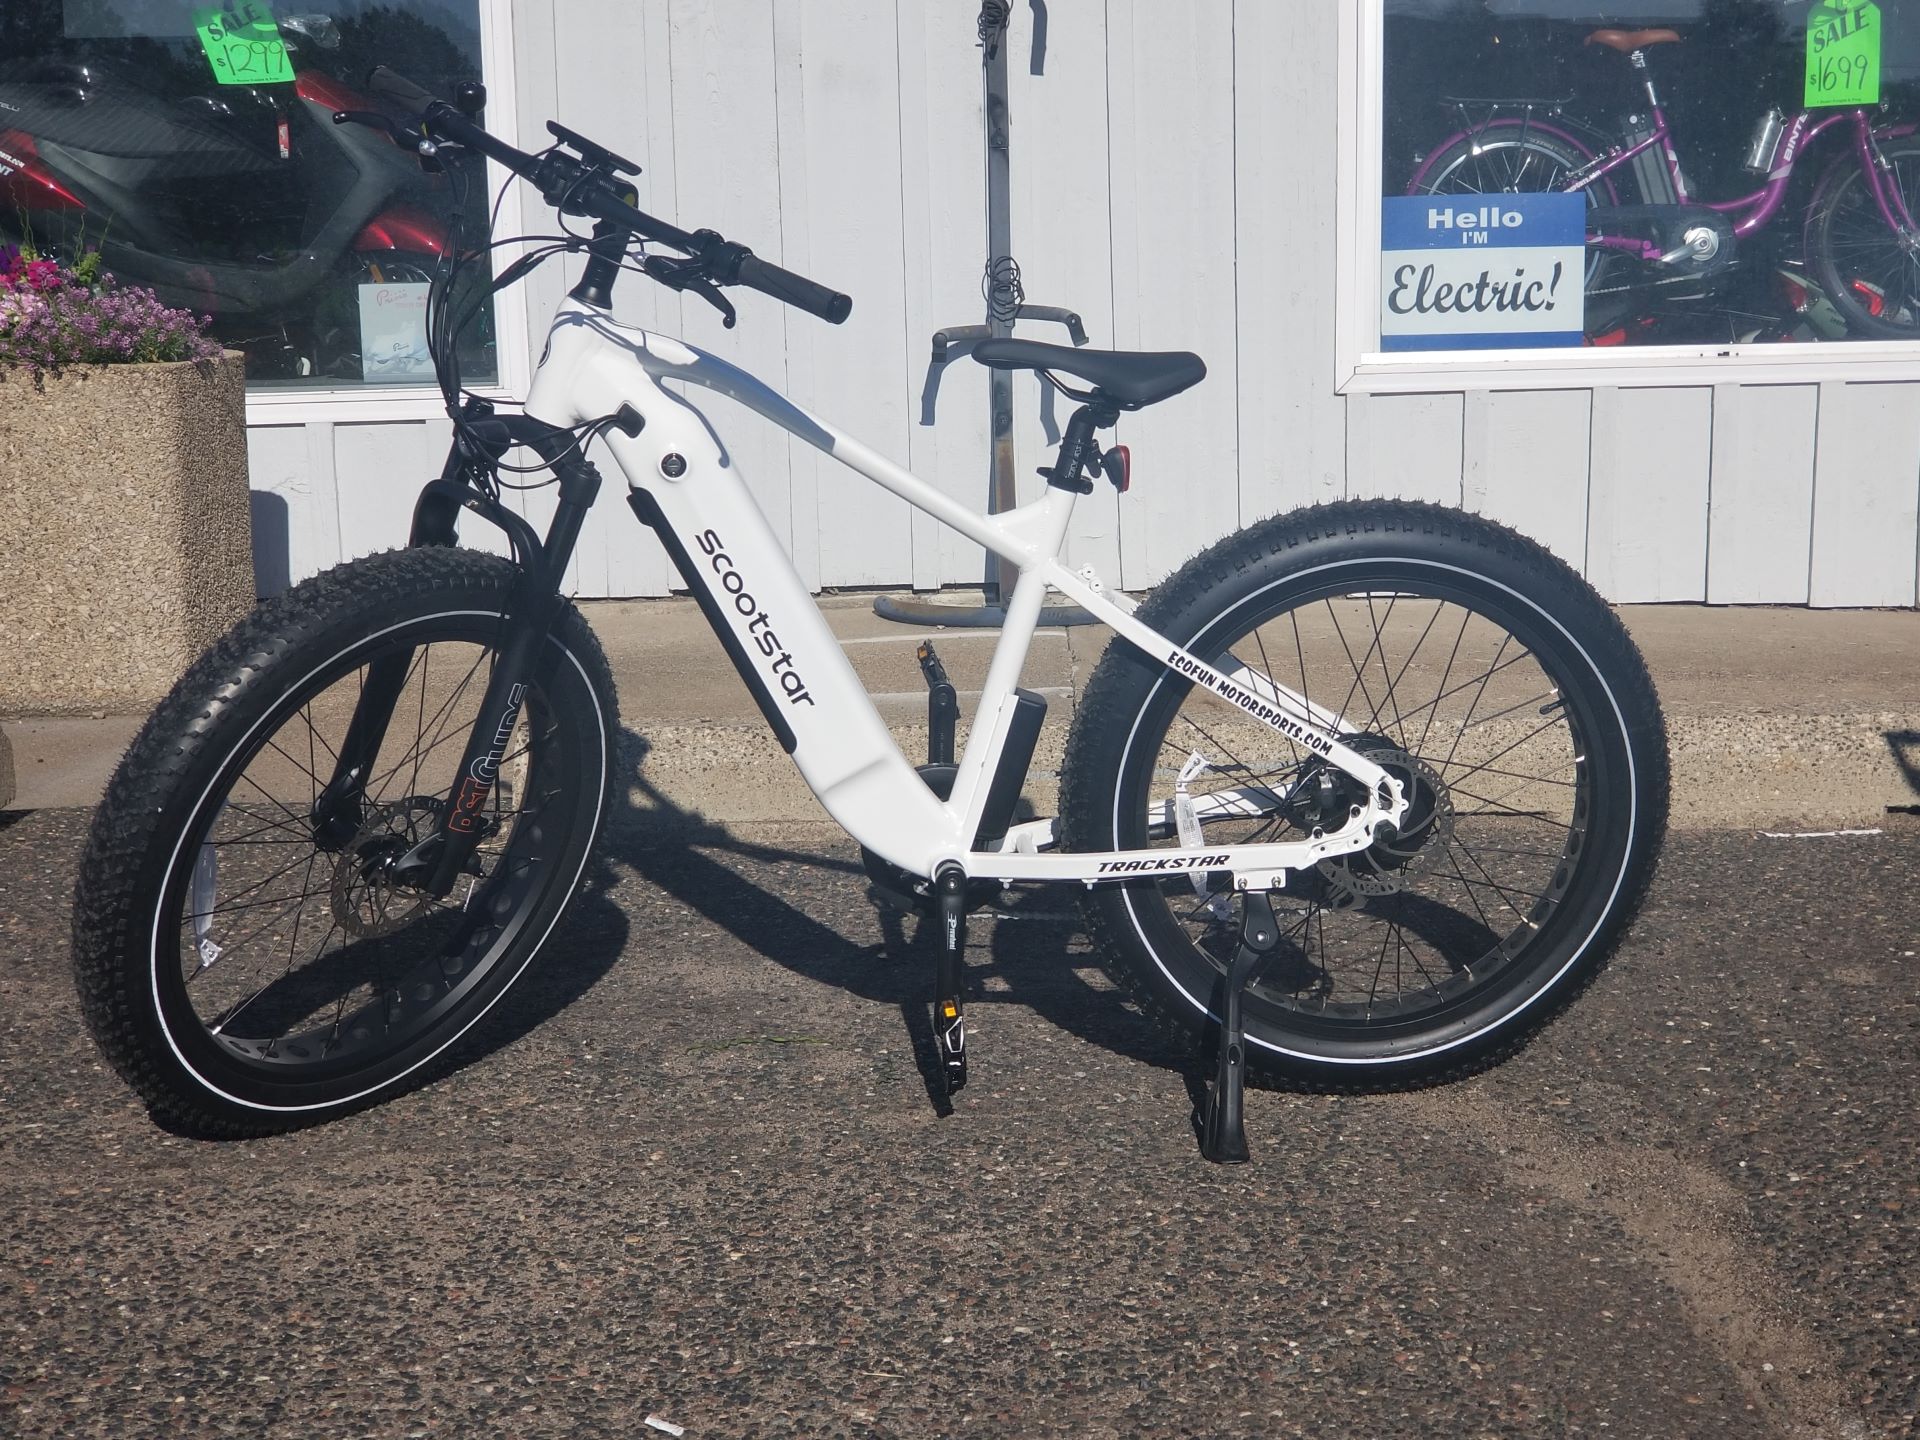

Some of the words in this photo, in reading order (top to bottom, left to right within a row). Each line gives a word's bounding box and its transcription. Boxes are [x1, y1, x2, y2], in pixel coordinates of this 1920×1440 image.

[207, 3, 261, 42] SALE
[1813, 6, 1870, 54] SALE
[216, 40, 284, 76] $1299
[1809, 54, 1869, 92] $1699
[1428, 206, 1524, 230] Hello
[1462, 231, 1488, 245] I'M
[1388, 260, 1562, 315] Electric!
[694, 528, 816, 708] scootstar
[1167, 650, 1218, 688] ECOFUN
[1216, 679, 1334, 757] MOTORSPORTS.COM
[1097, 854, 1231, 873] TRACKSTAR
